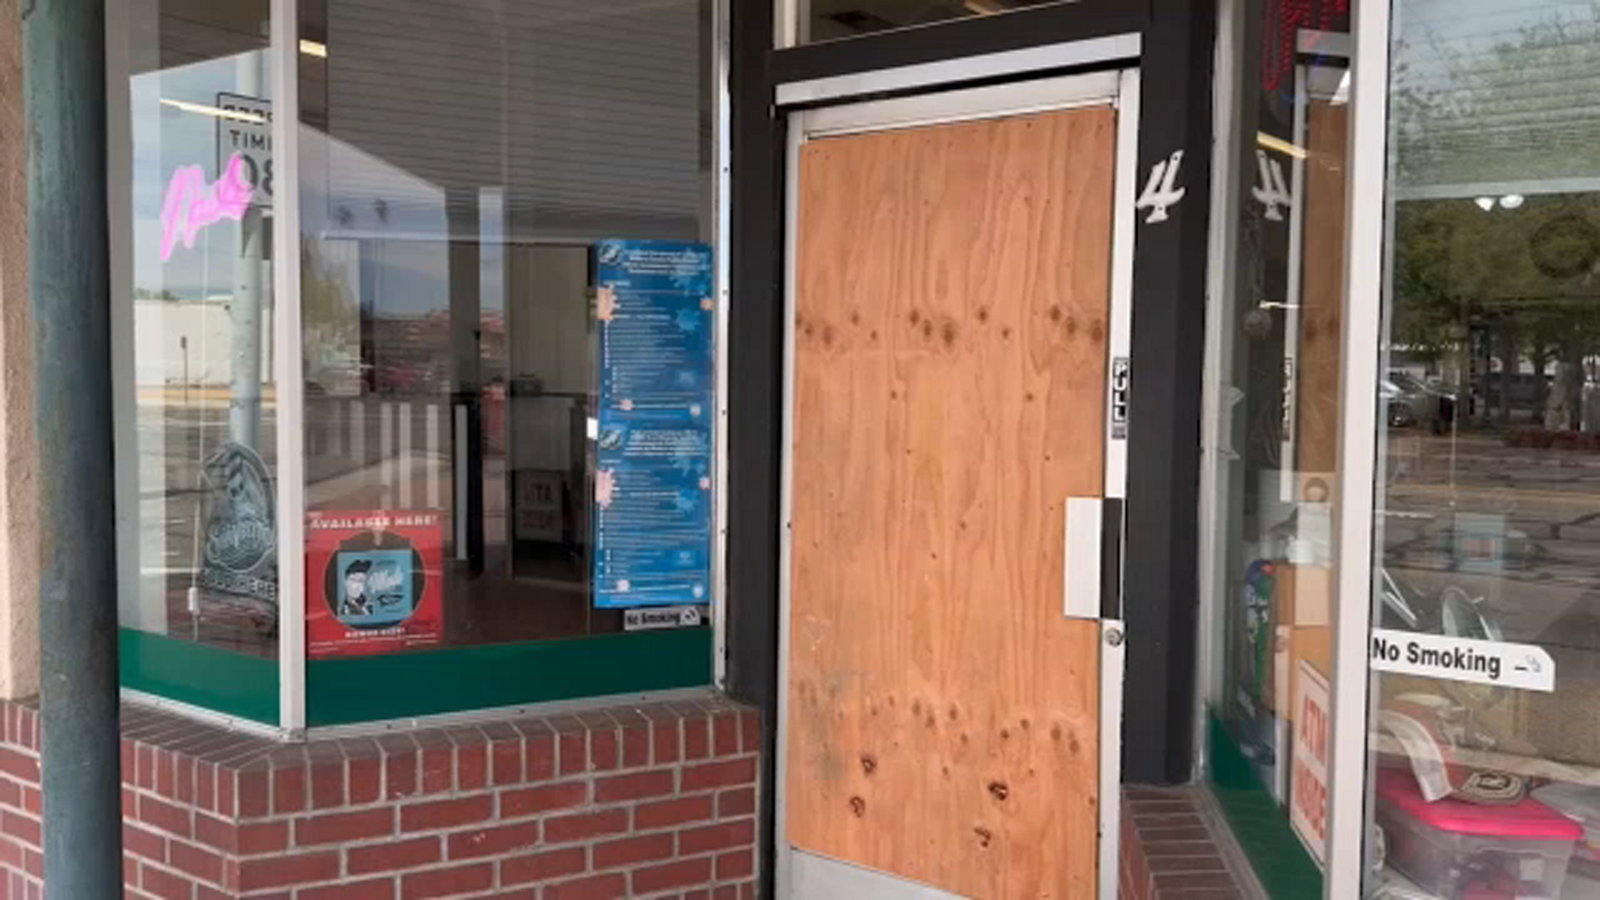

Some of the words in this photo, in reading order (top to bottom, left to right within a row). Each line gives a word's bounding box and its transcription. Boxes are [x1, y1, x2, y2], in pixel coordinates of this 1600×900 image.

[1135, 150, 1185, 223] 4
[1372, 637, 1400, 661] No
[1406, 640, 1501, 680] Smoking
